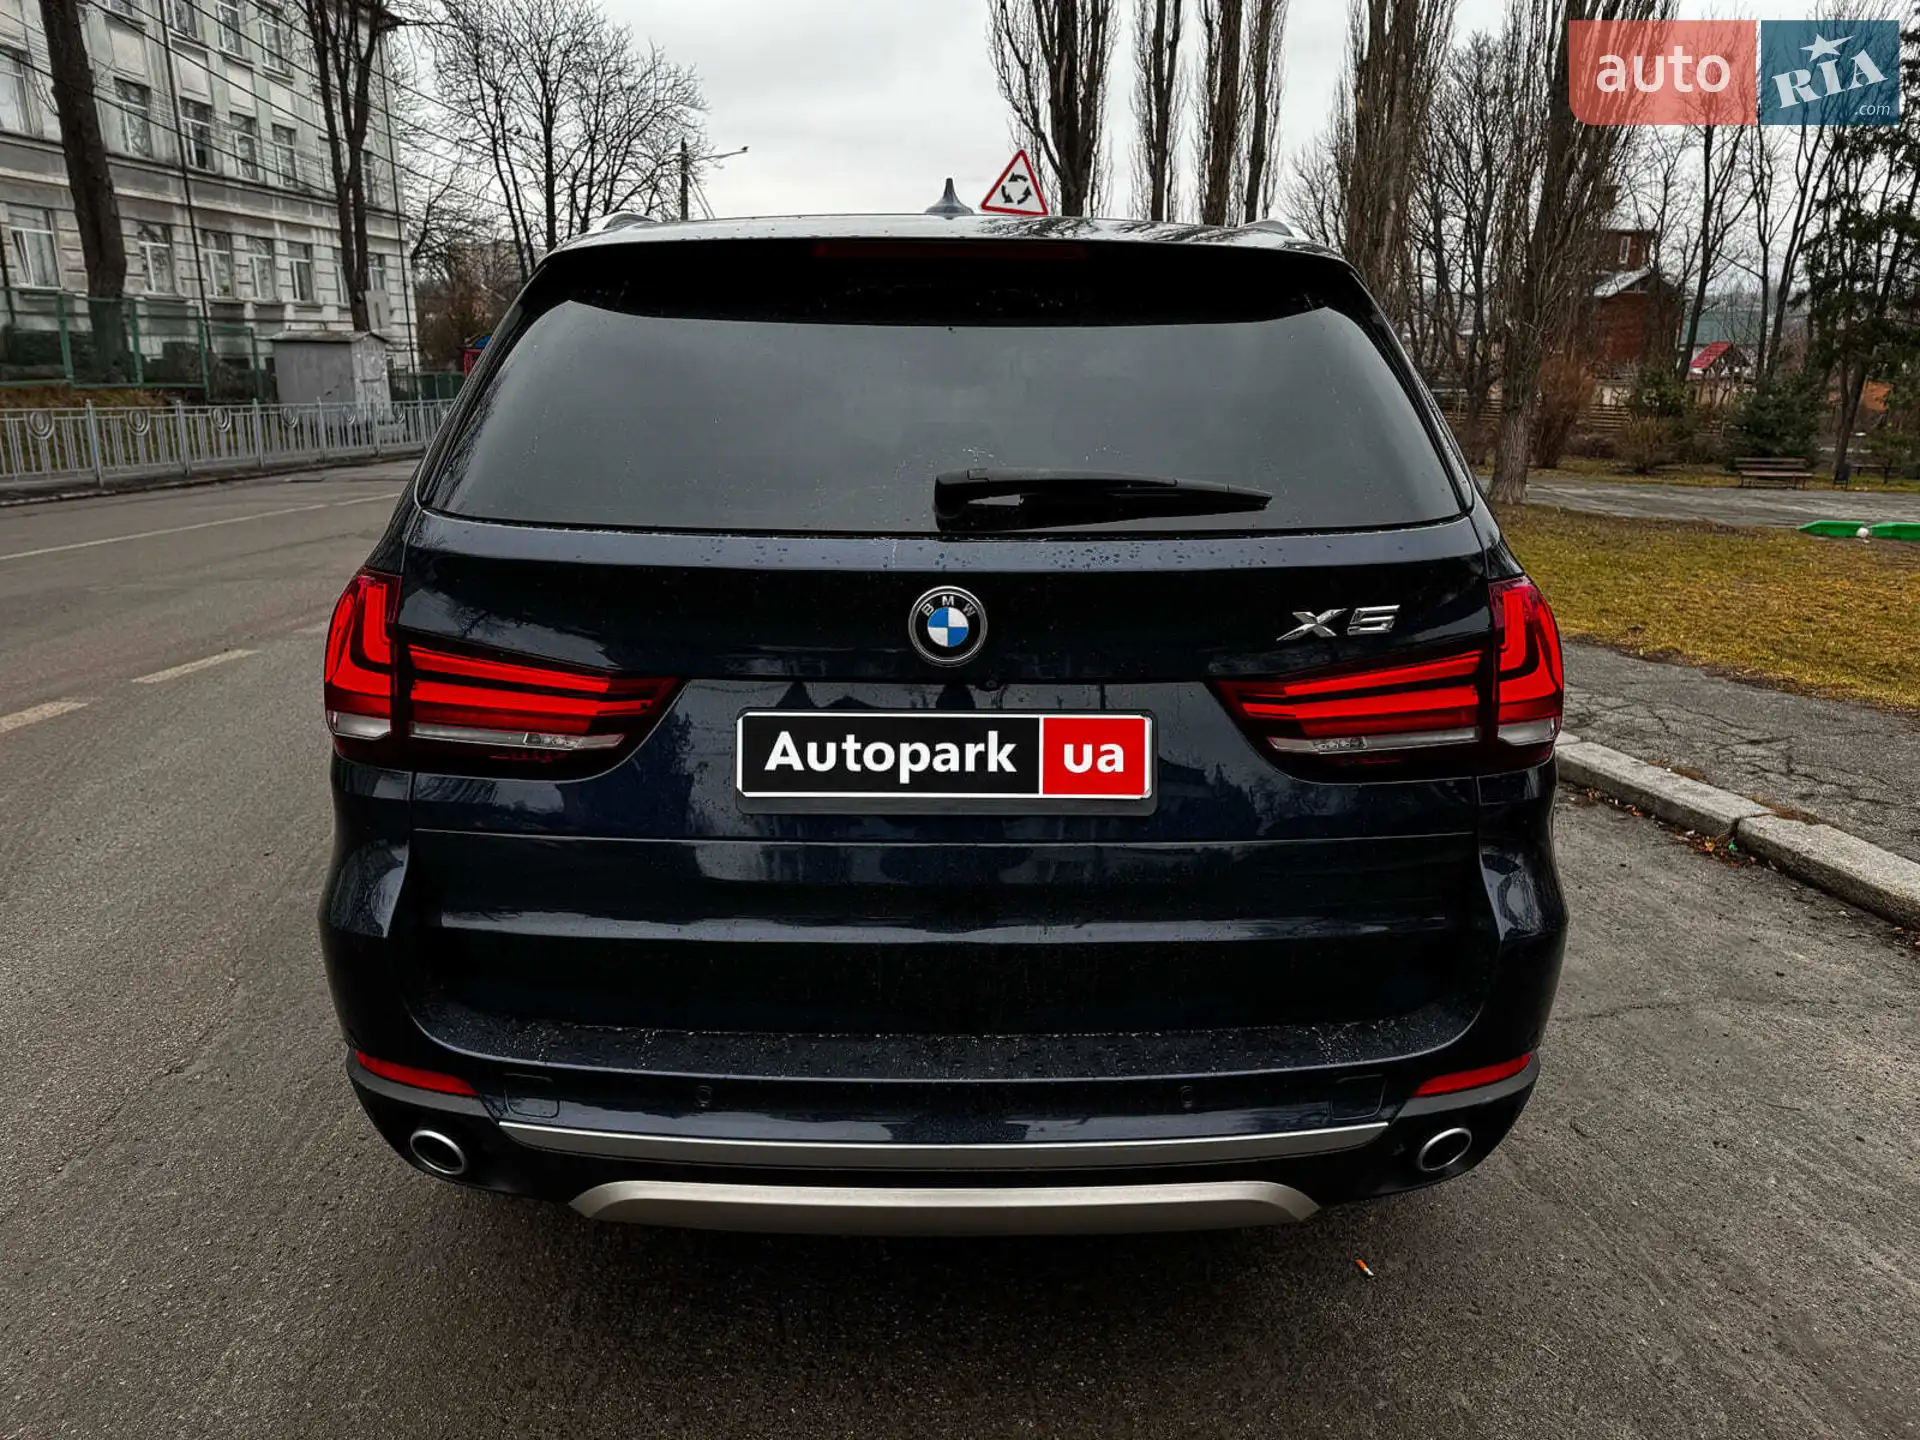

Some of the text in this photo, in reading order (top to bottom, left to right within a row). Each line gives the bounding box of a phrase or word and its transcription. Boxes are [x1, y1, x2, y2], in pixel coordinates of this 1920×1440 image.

[921, 595, 976, 617] BMW
[1276, 604, 1401, 642] X5
[764, 730, 1125, 784] Autopark ua
